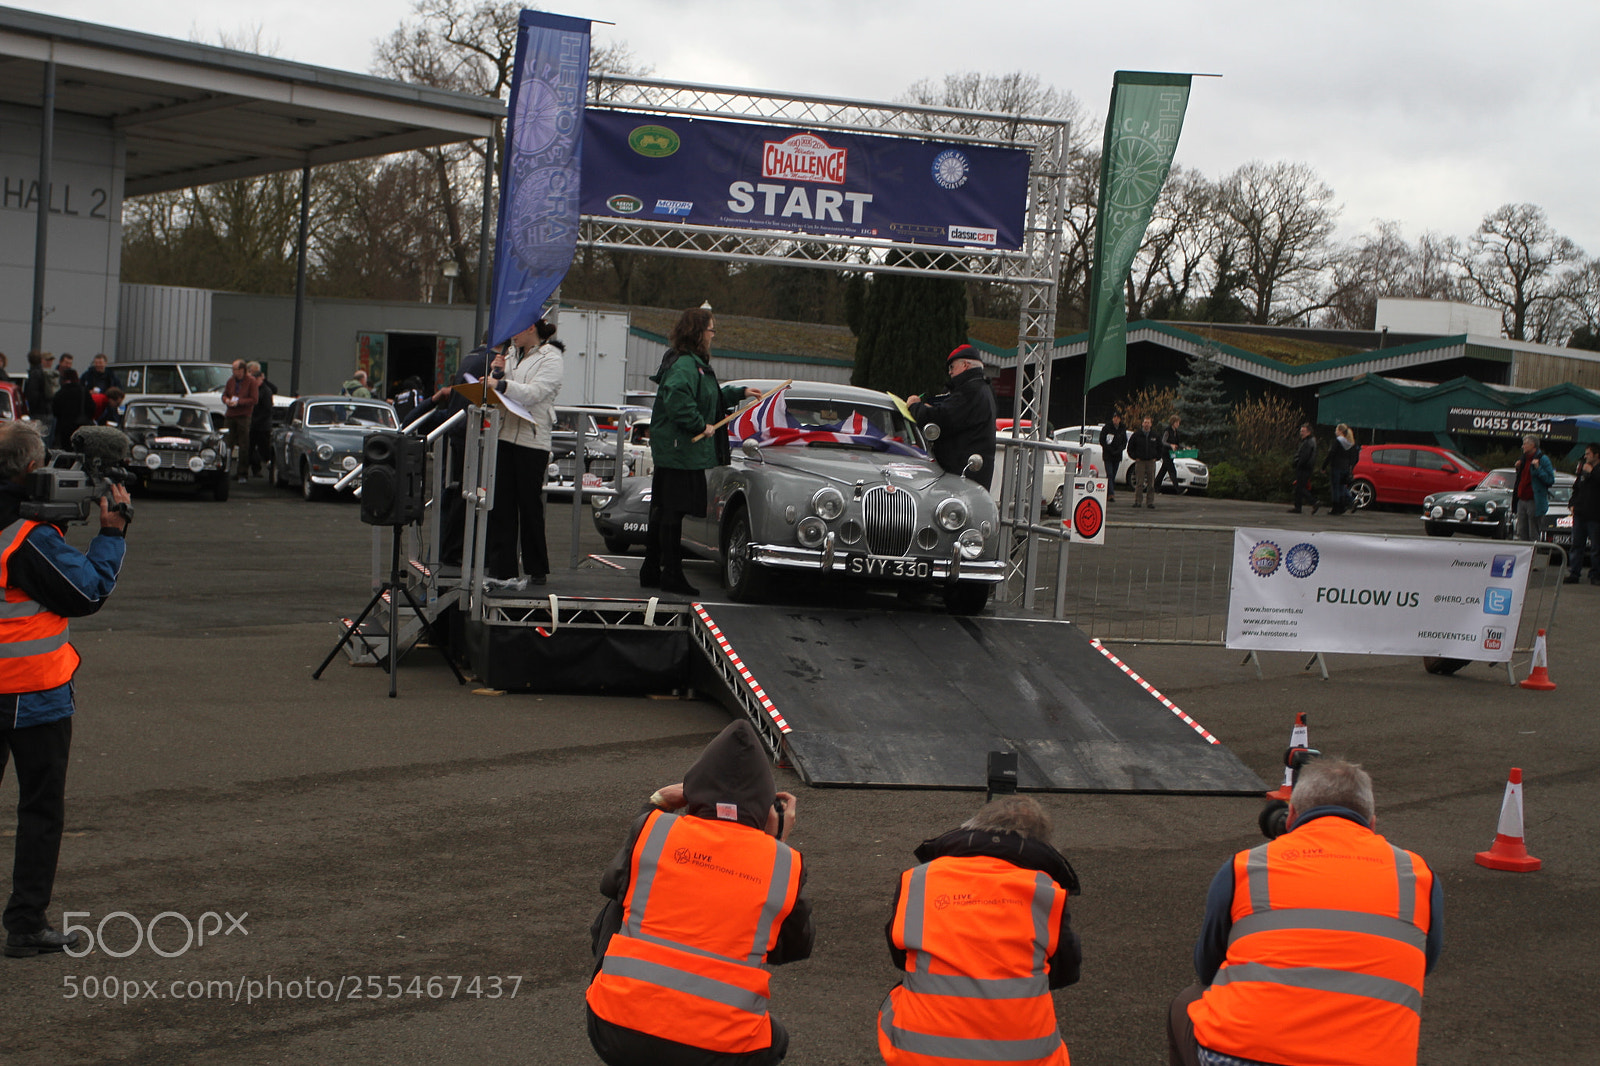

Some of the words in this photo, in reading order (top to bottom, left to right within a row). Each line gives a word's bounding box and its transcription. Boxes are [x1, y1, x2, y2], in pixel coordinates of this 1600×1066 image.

[766, 145, 844, 182] CHALLENGE
[4, 176, 79, 216] HALL
[90, 188, 107, 219] 2
[727, 180, 873, 224] START
[656, 200, 692, 209] MOTORS
[127, 369, 140, 387] 19
[1450, 408, 1473, 416] ANCHOR
[1473, 409, 1506, 418] EXHIBITIONS
[1511, 411, 1541, 420] ELECTRICAL
[1473, 417, 1509, 431] 01455
[1511, 419, 1552, 434] 612341
[623, 522, 638, 532] 849
[852, 557, 888, 575] SVY
[893, 560, 929, 578] 330
[1451, 559, 1487, 569] /herorally
[1316, 587, 1392, 606] FOLLOW
[1396, 591, 1420, 607] US
[1434, 594, 1480, 606] @HERO_CRA
[1244, 605, 1304, 614] www.heroevents.eu
[1243, 618, 1298, 626] www.craevents.eu
[1242, 629, 1298, 638] www.herostore.eu
[1418, 631, 1477, 642] HEROEVENTSEU
[1486, 628, 1502, 640] You
[1485, 640, 1500, 649] Tube
[693, 852, 712, 862] LIVE
[691, 860, 735, 876] PROMOTIONS
[739, 872, 762, 884] EVENTS
